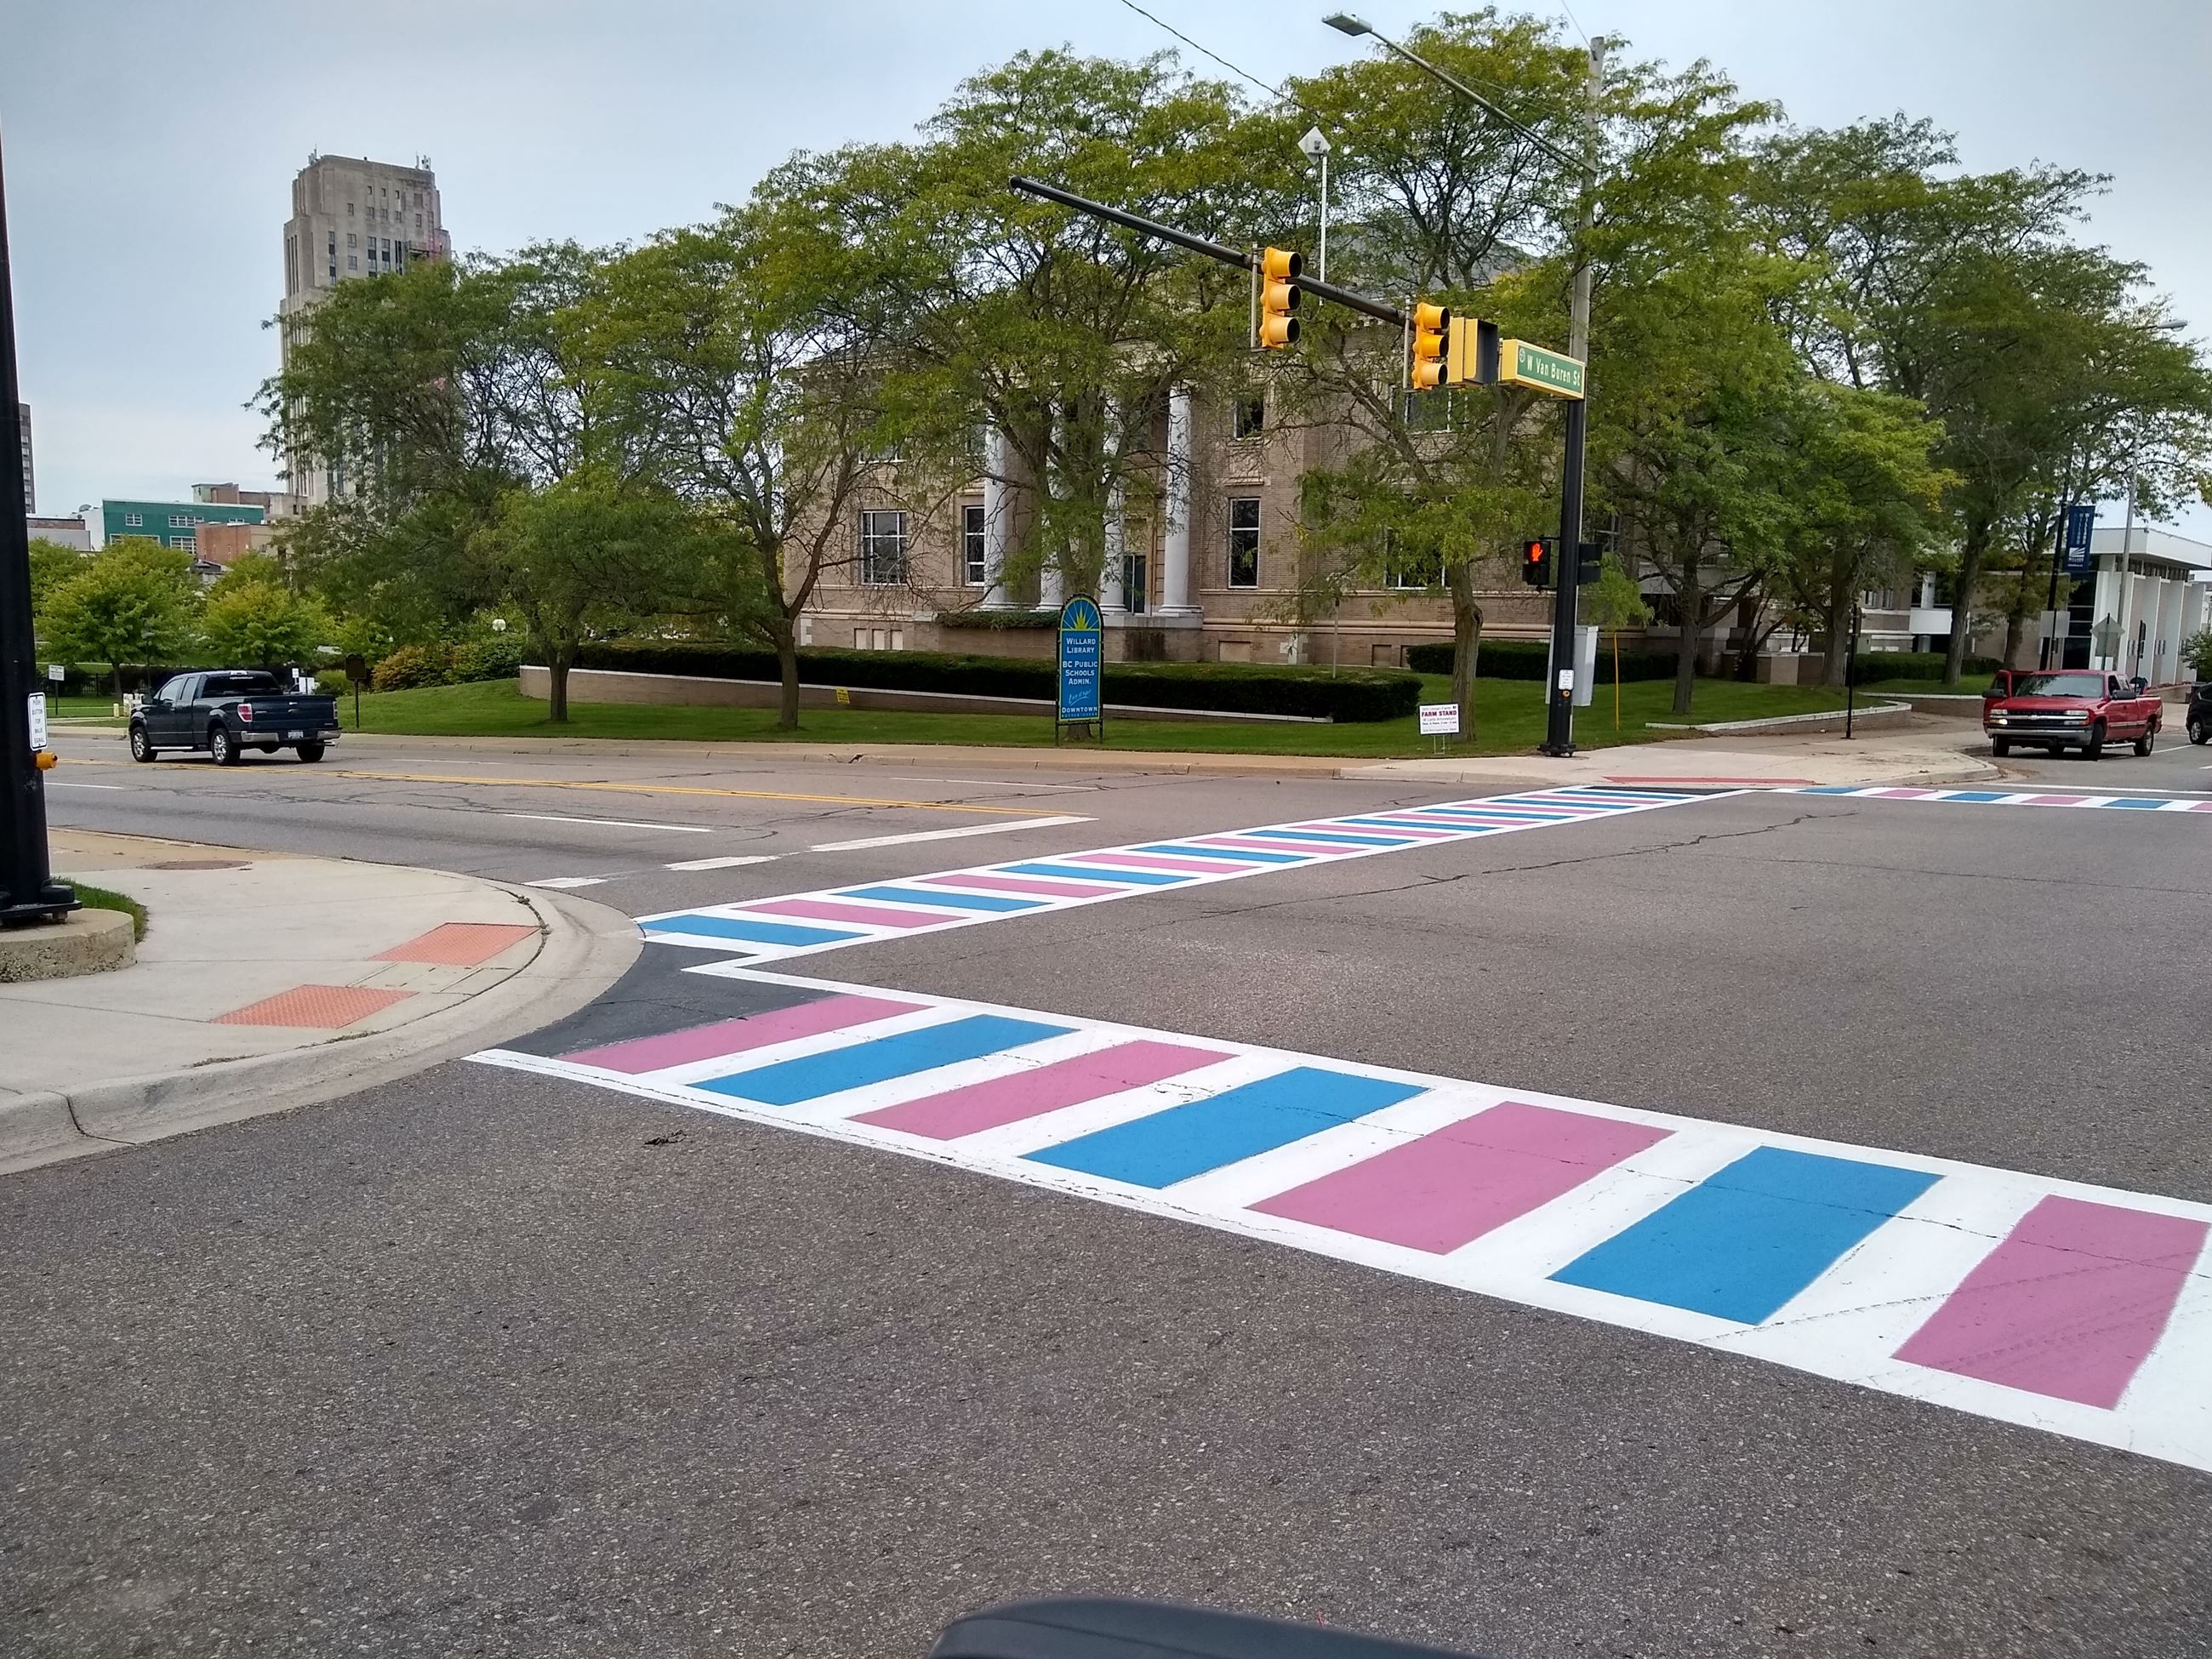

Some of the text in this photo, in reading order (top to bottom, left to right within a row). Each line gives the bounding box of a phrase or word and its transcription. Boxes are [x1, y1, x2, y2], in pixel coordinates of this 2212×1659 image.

[1527, 355, 1581, 386] W Van Buren St
